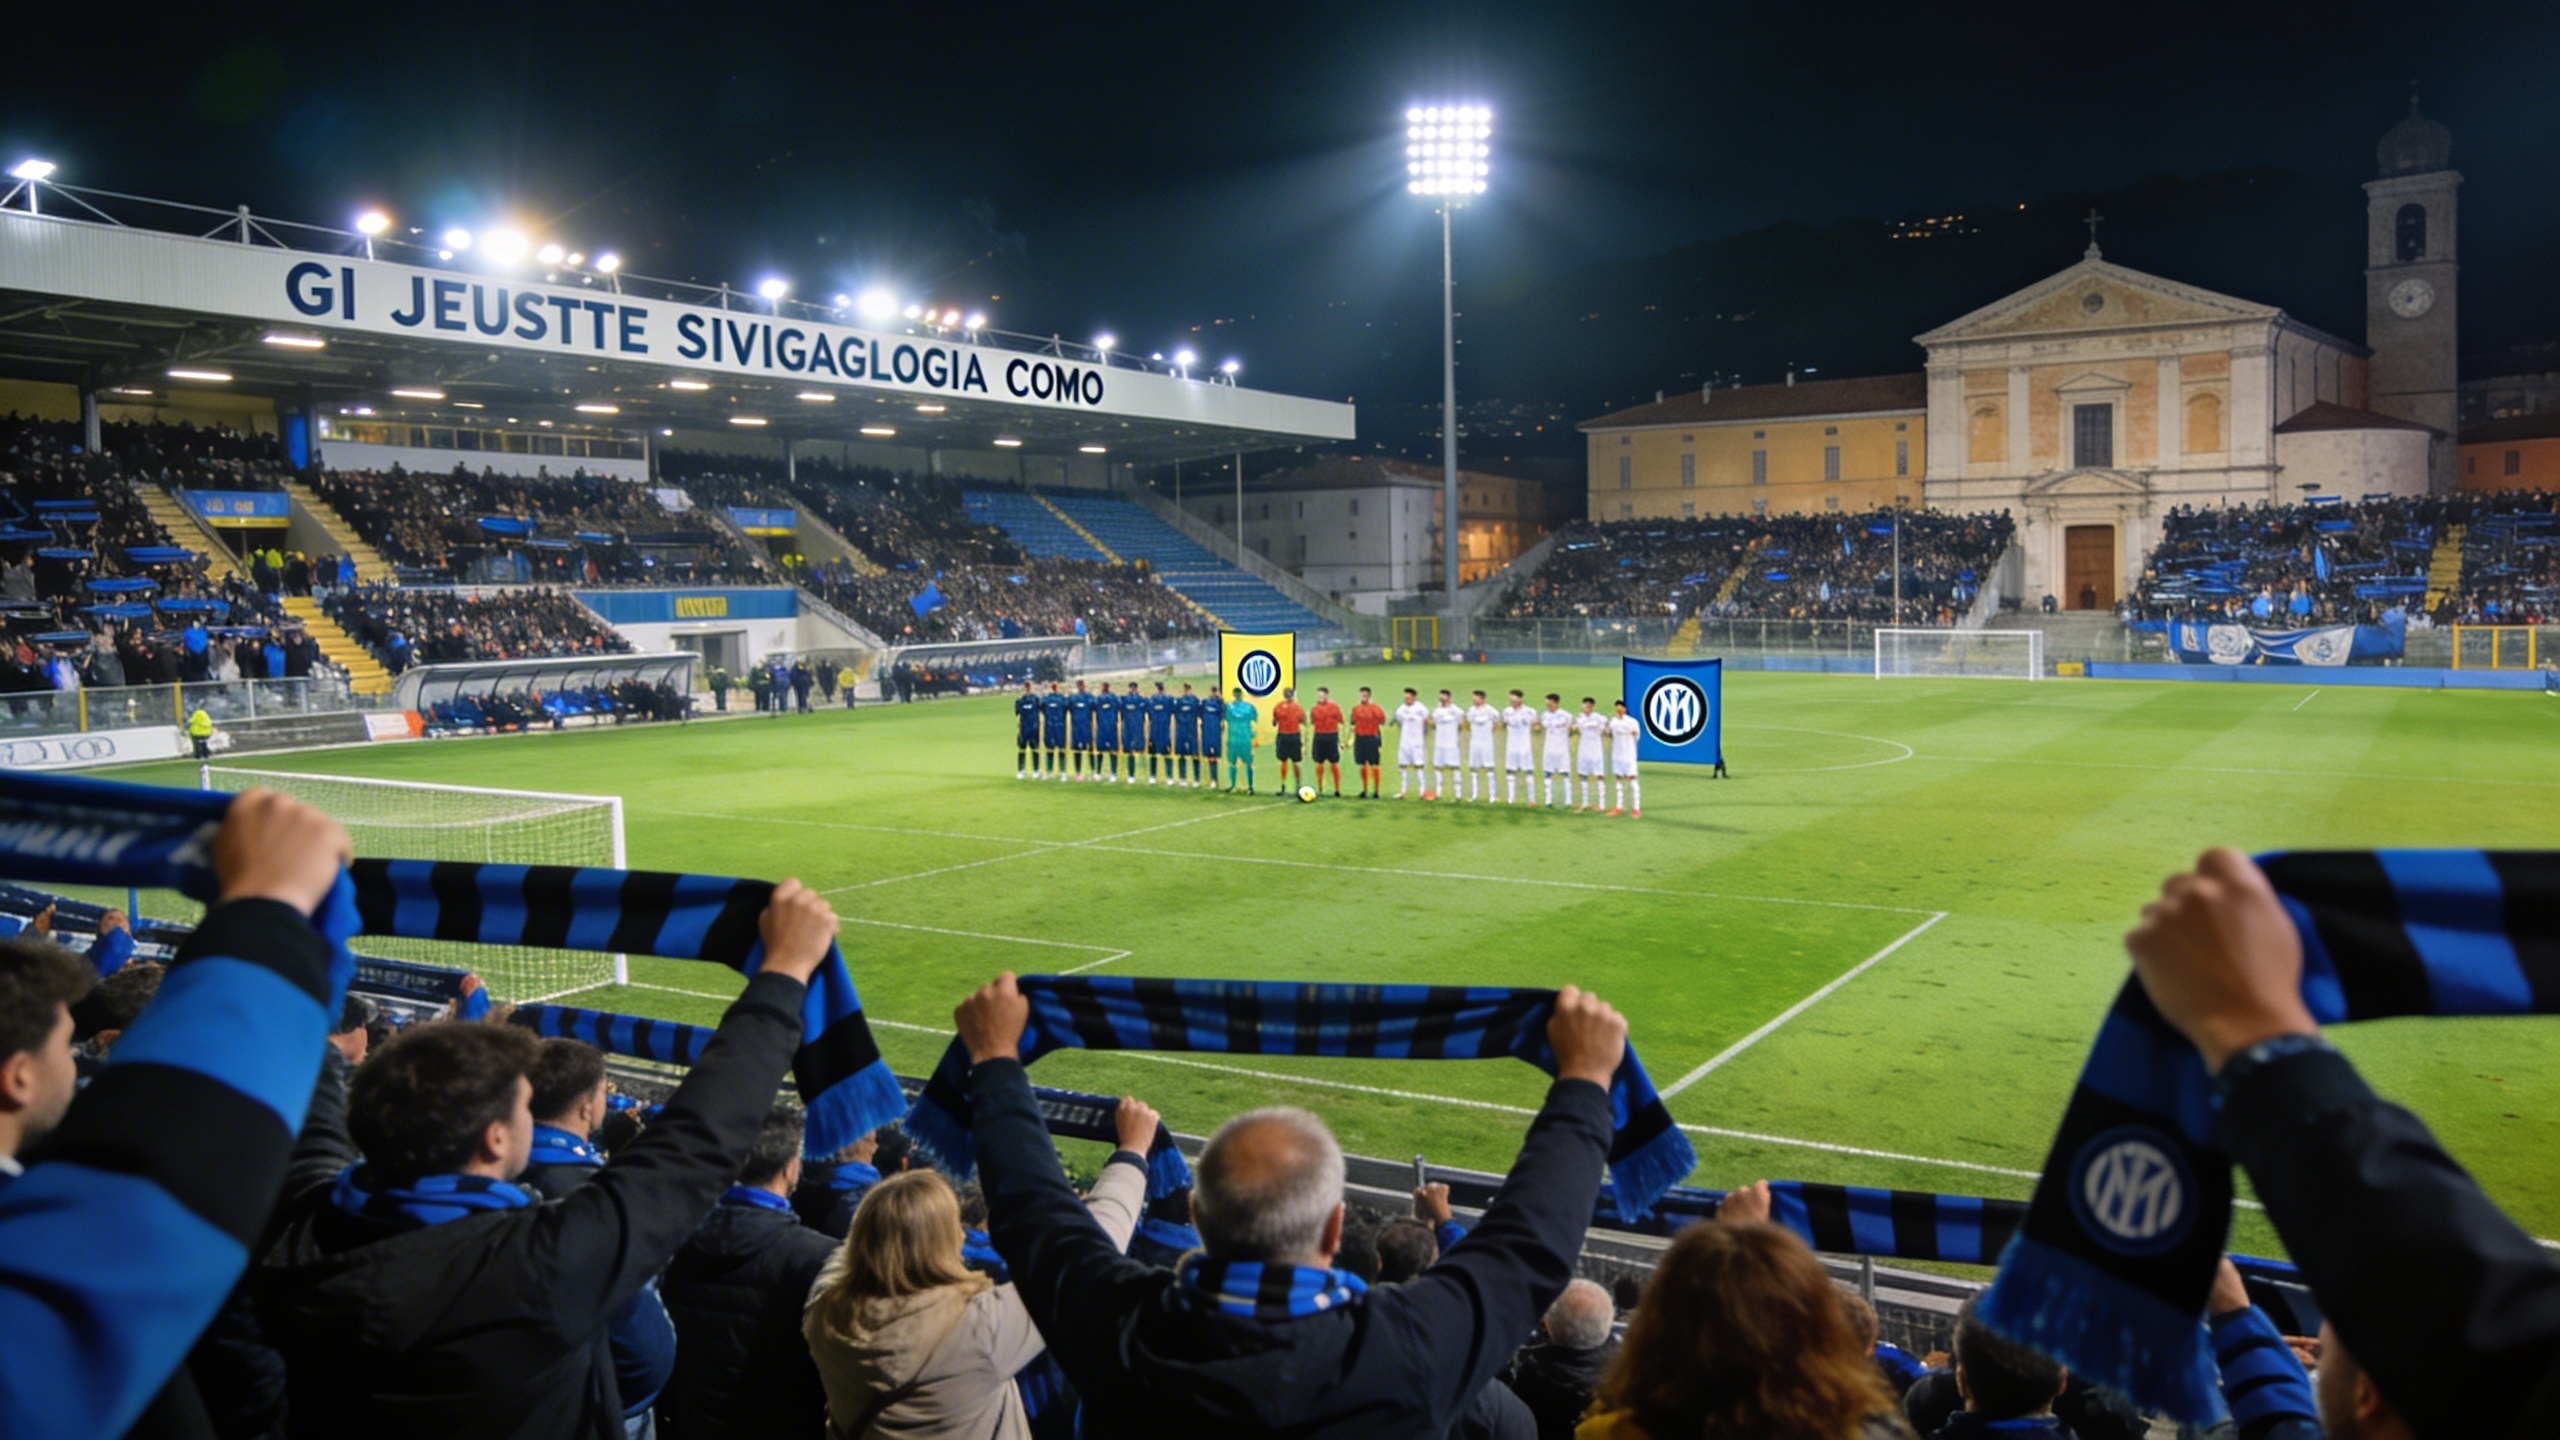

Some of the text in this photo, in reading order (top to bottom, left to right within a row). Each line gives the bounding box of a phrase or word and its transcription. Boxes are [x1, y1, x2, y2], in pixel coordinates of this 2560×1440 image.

[286, 262, 355, 320] GI
[391, 276, 649, 354] JEUSTTE
[1005, 358, 1104, 405] COMO
